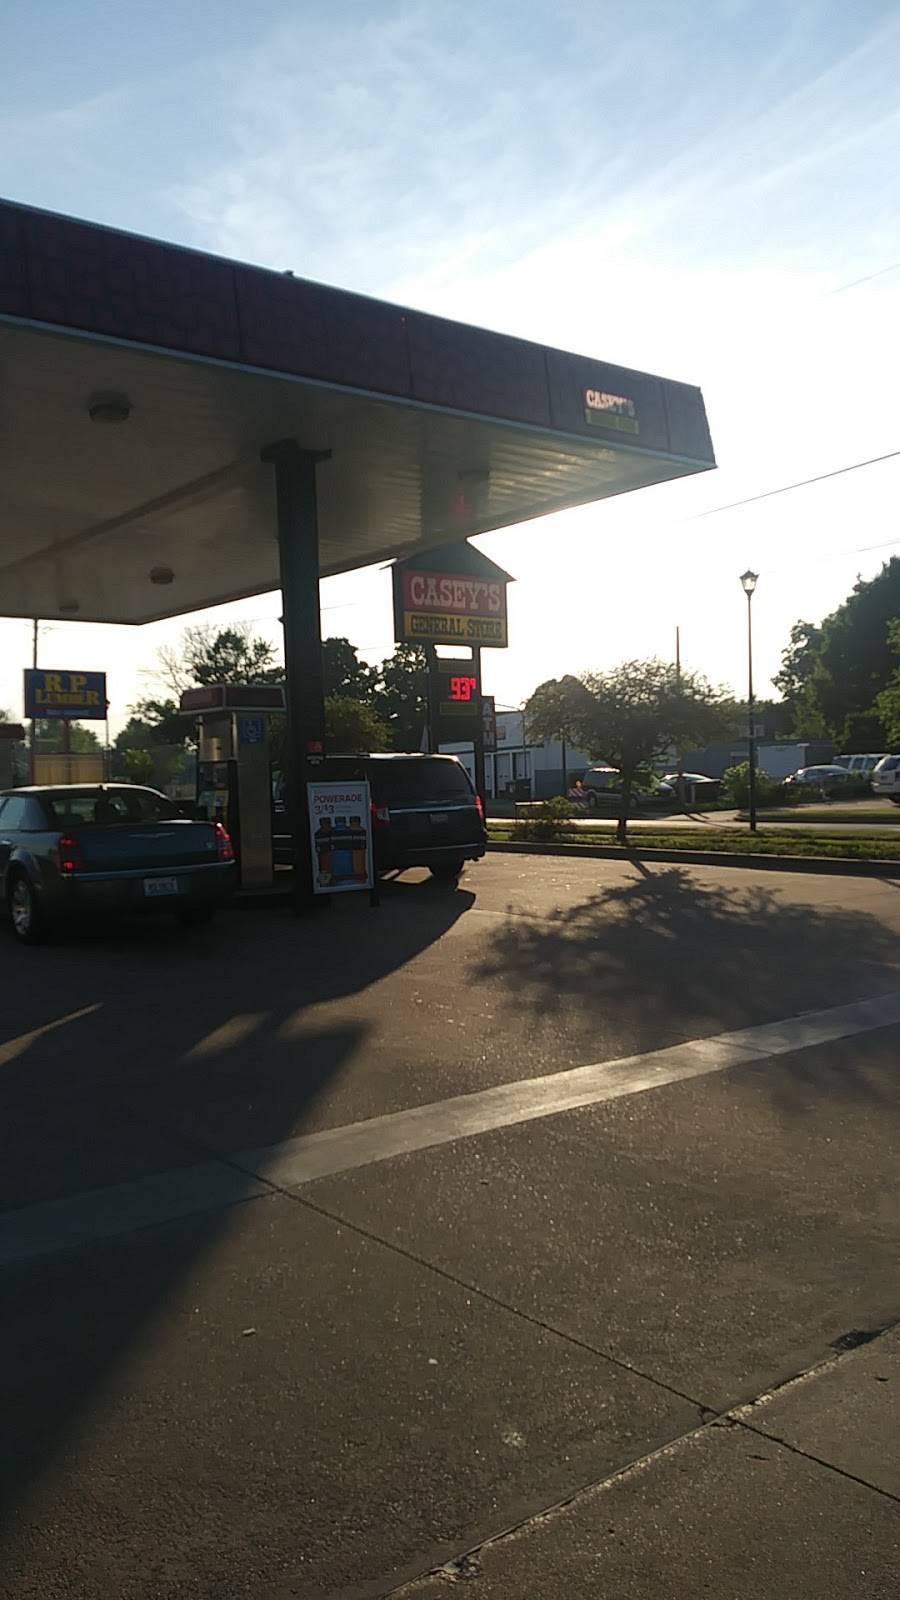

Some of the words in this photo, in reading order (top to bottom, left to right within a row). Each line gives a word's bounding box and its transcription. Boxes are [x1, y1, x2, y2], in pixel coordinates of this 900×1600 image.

[410, 576, 501, 611] CASEY'S
[411, 615, 465, 636] GENERAL
[467, 620, 501, 639] STORE
[313, 793, 362, 804] POWERADE
